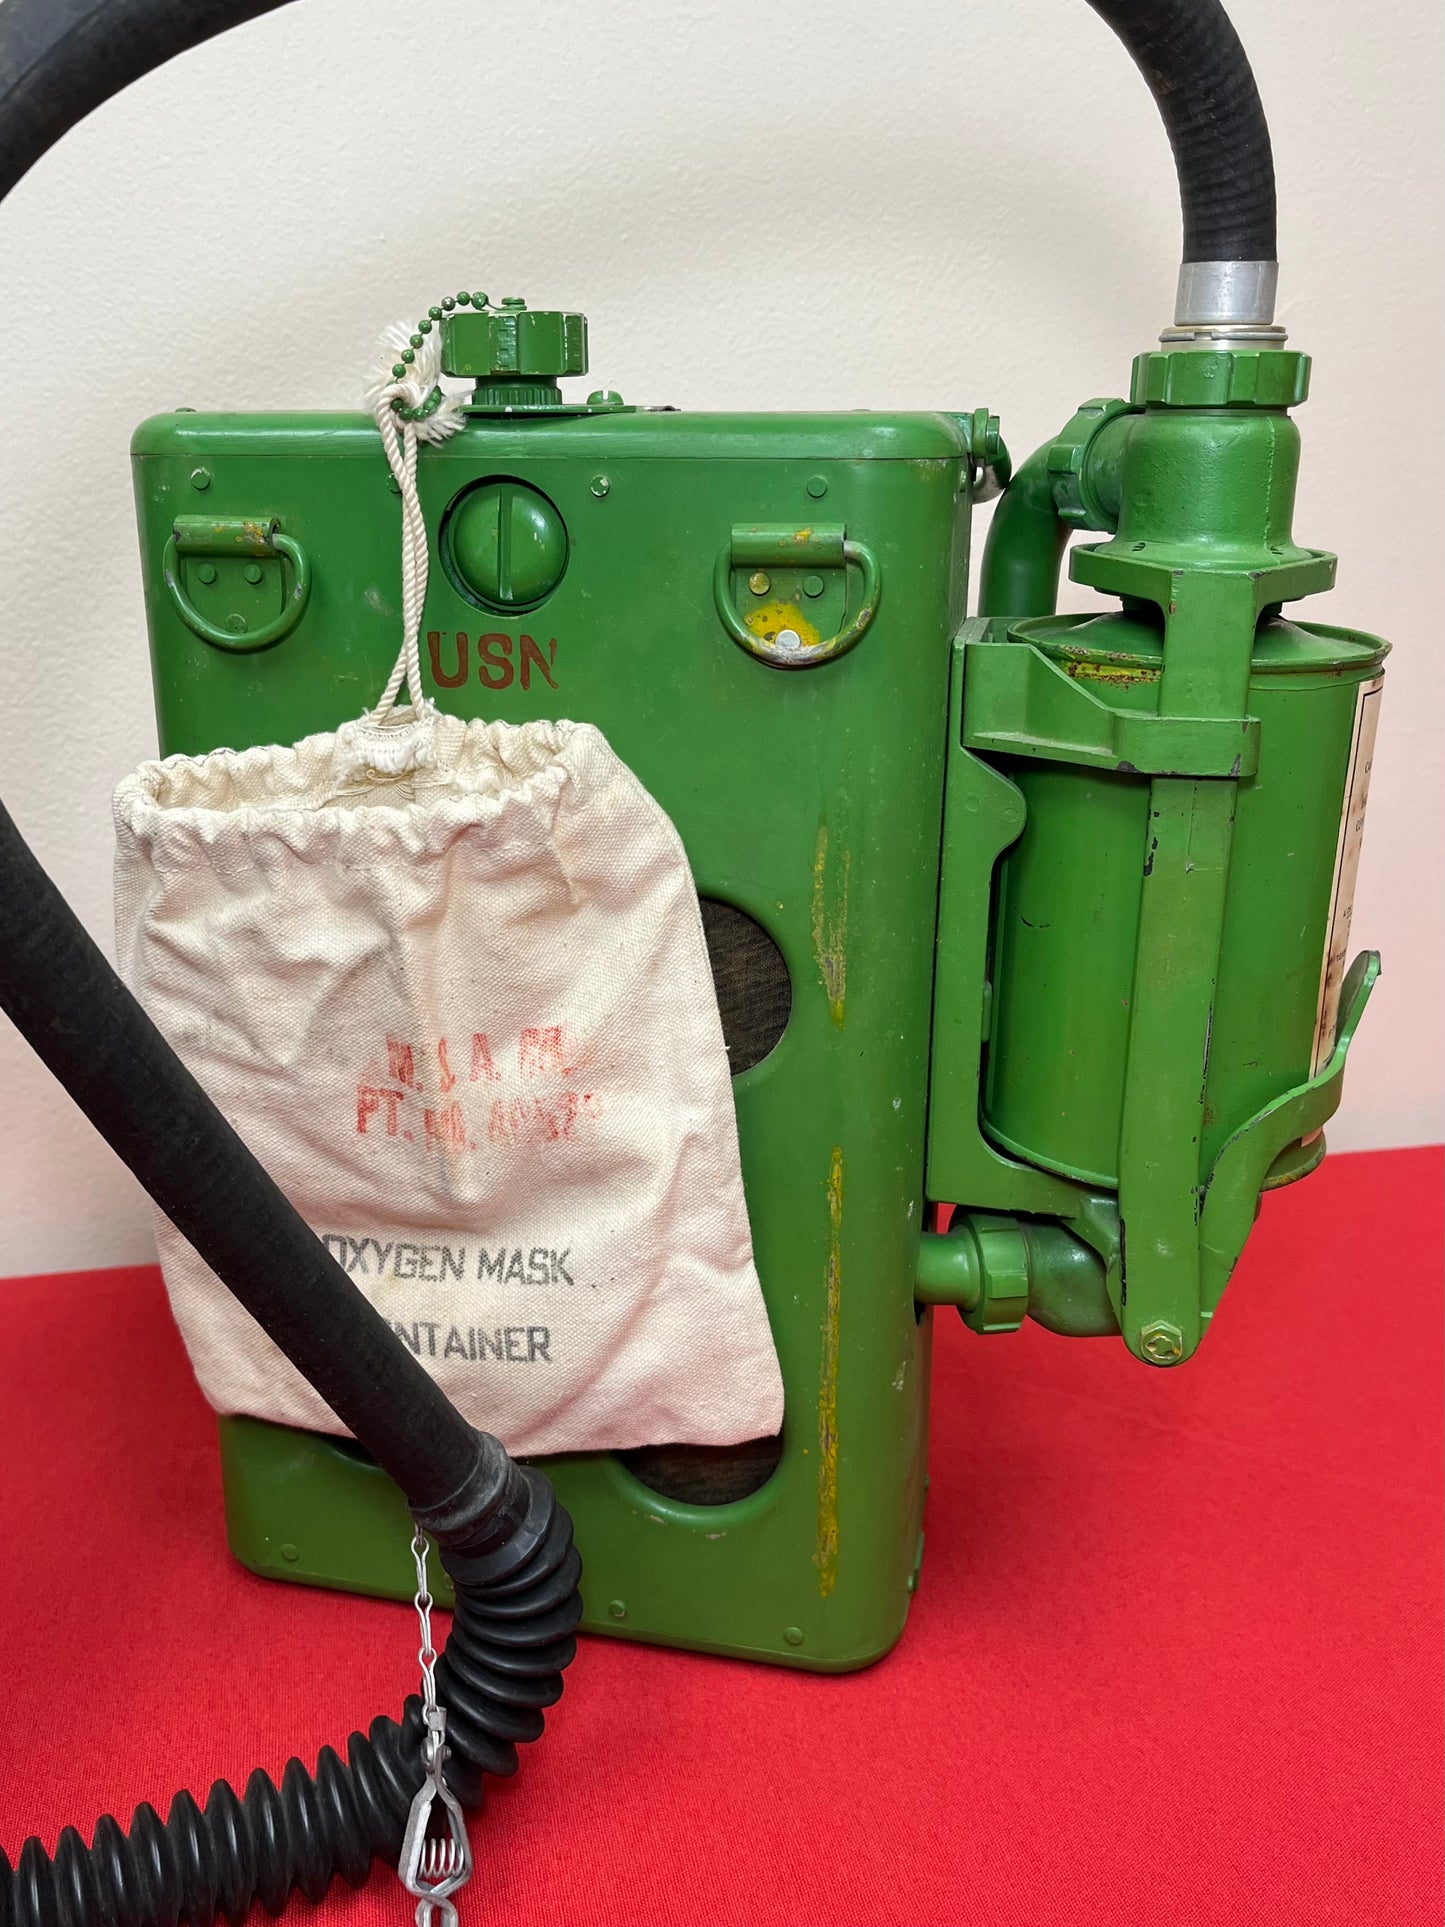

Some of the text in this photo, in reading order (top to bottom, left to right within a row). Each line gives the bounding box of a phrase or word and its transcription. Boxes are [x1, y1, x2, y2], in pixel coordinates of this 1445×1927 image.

[427, 631, 559, 691] USN
[322, 1234, 575, 1287] OXYGEN MASK
[383, 1318, 553, 1362] NTAINER
